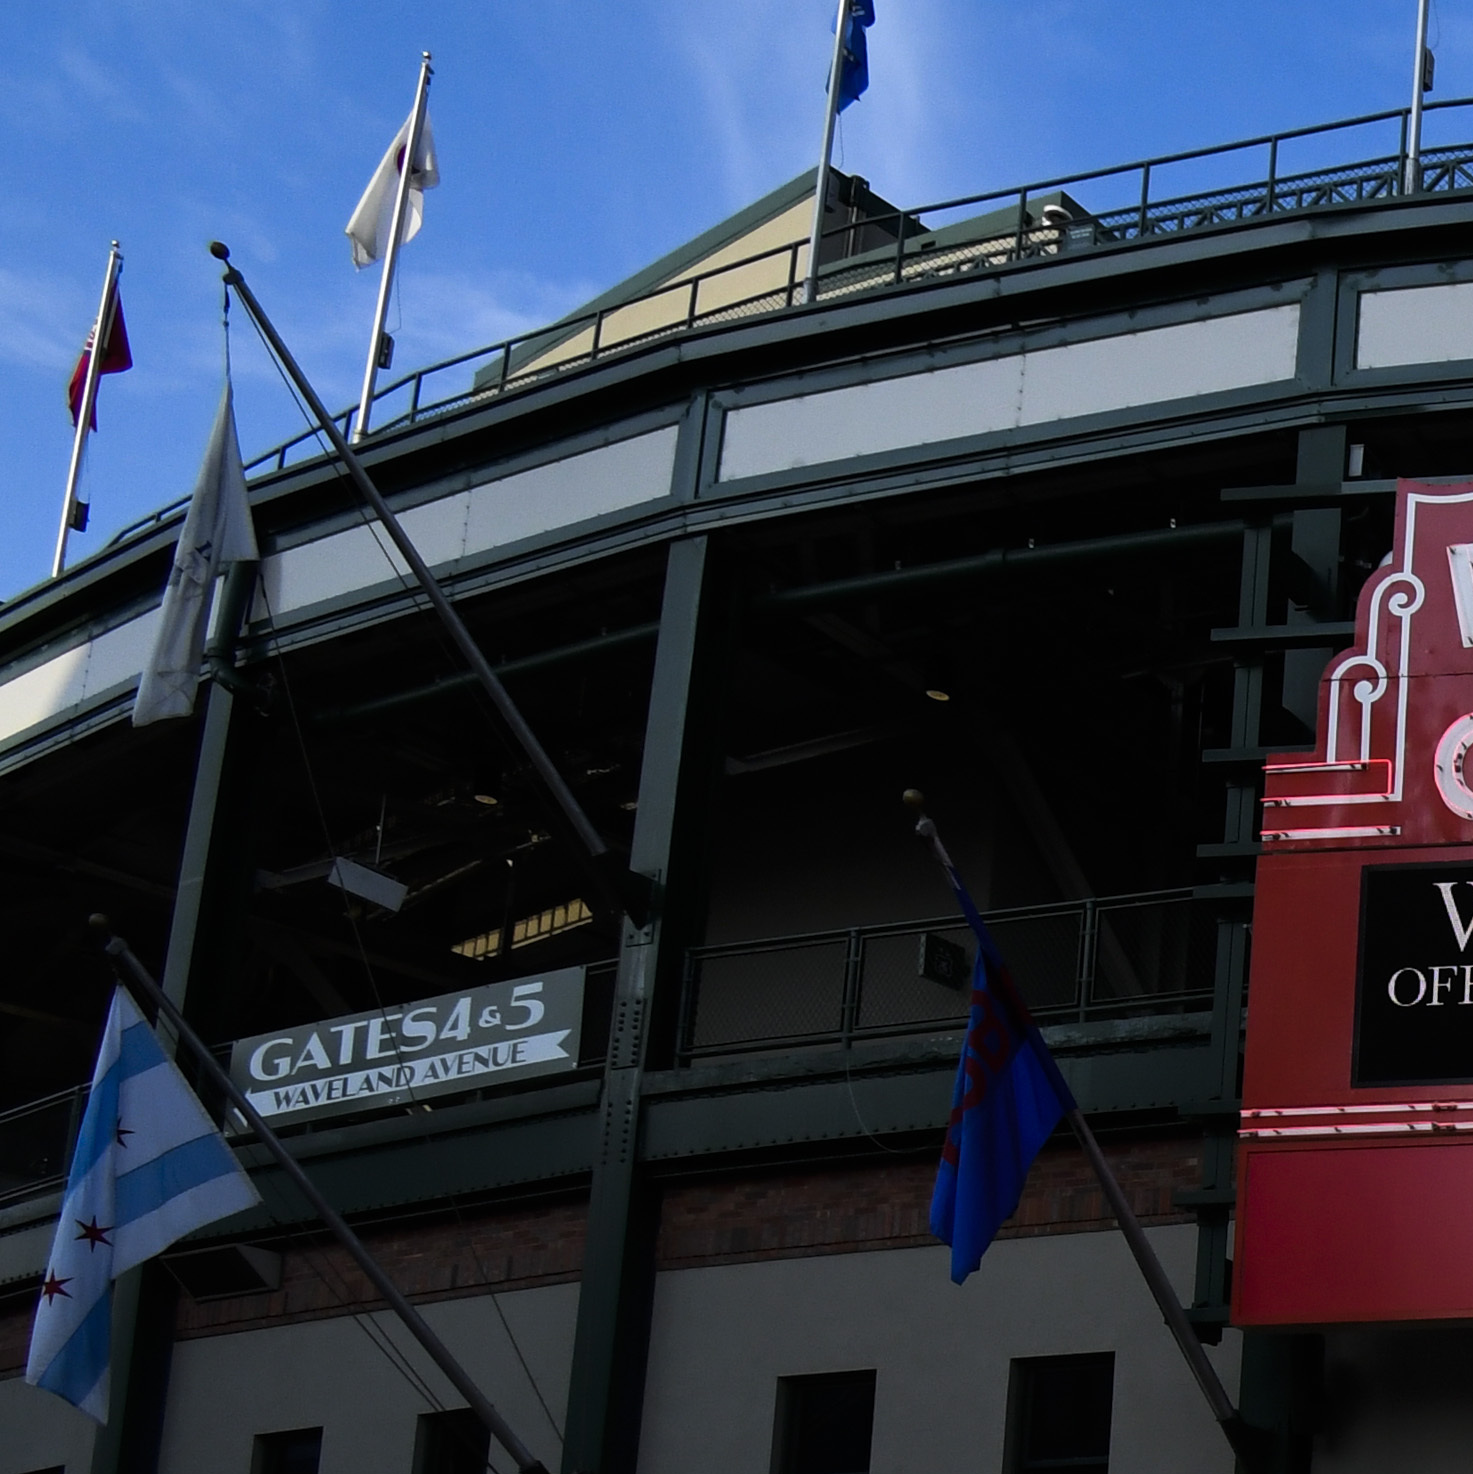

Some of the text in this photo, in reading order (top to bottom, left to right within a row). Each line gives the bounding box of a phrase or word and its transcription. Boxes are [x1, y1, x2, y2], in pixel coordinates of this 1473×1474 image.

[249, 981, 545, 1081] GATES 4 & 5
[274, 1040, 528, 1111] WAVELAND AVENUE
